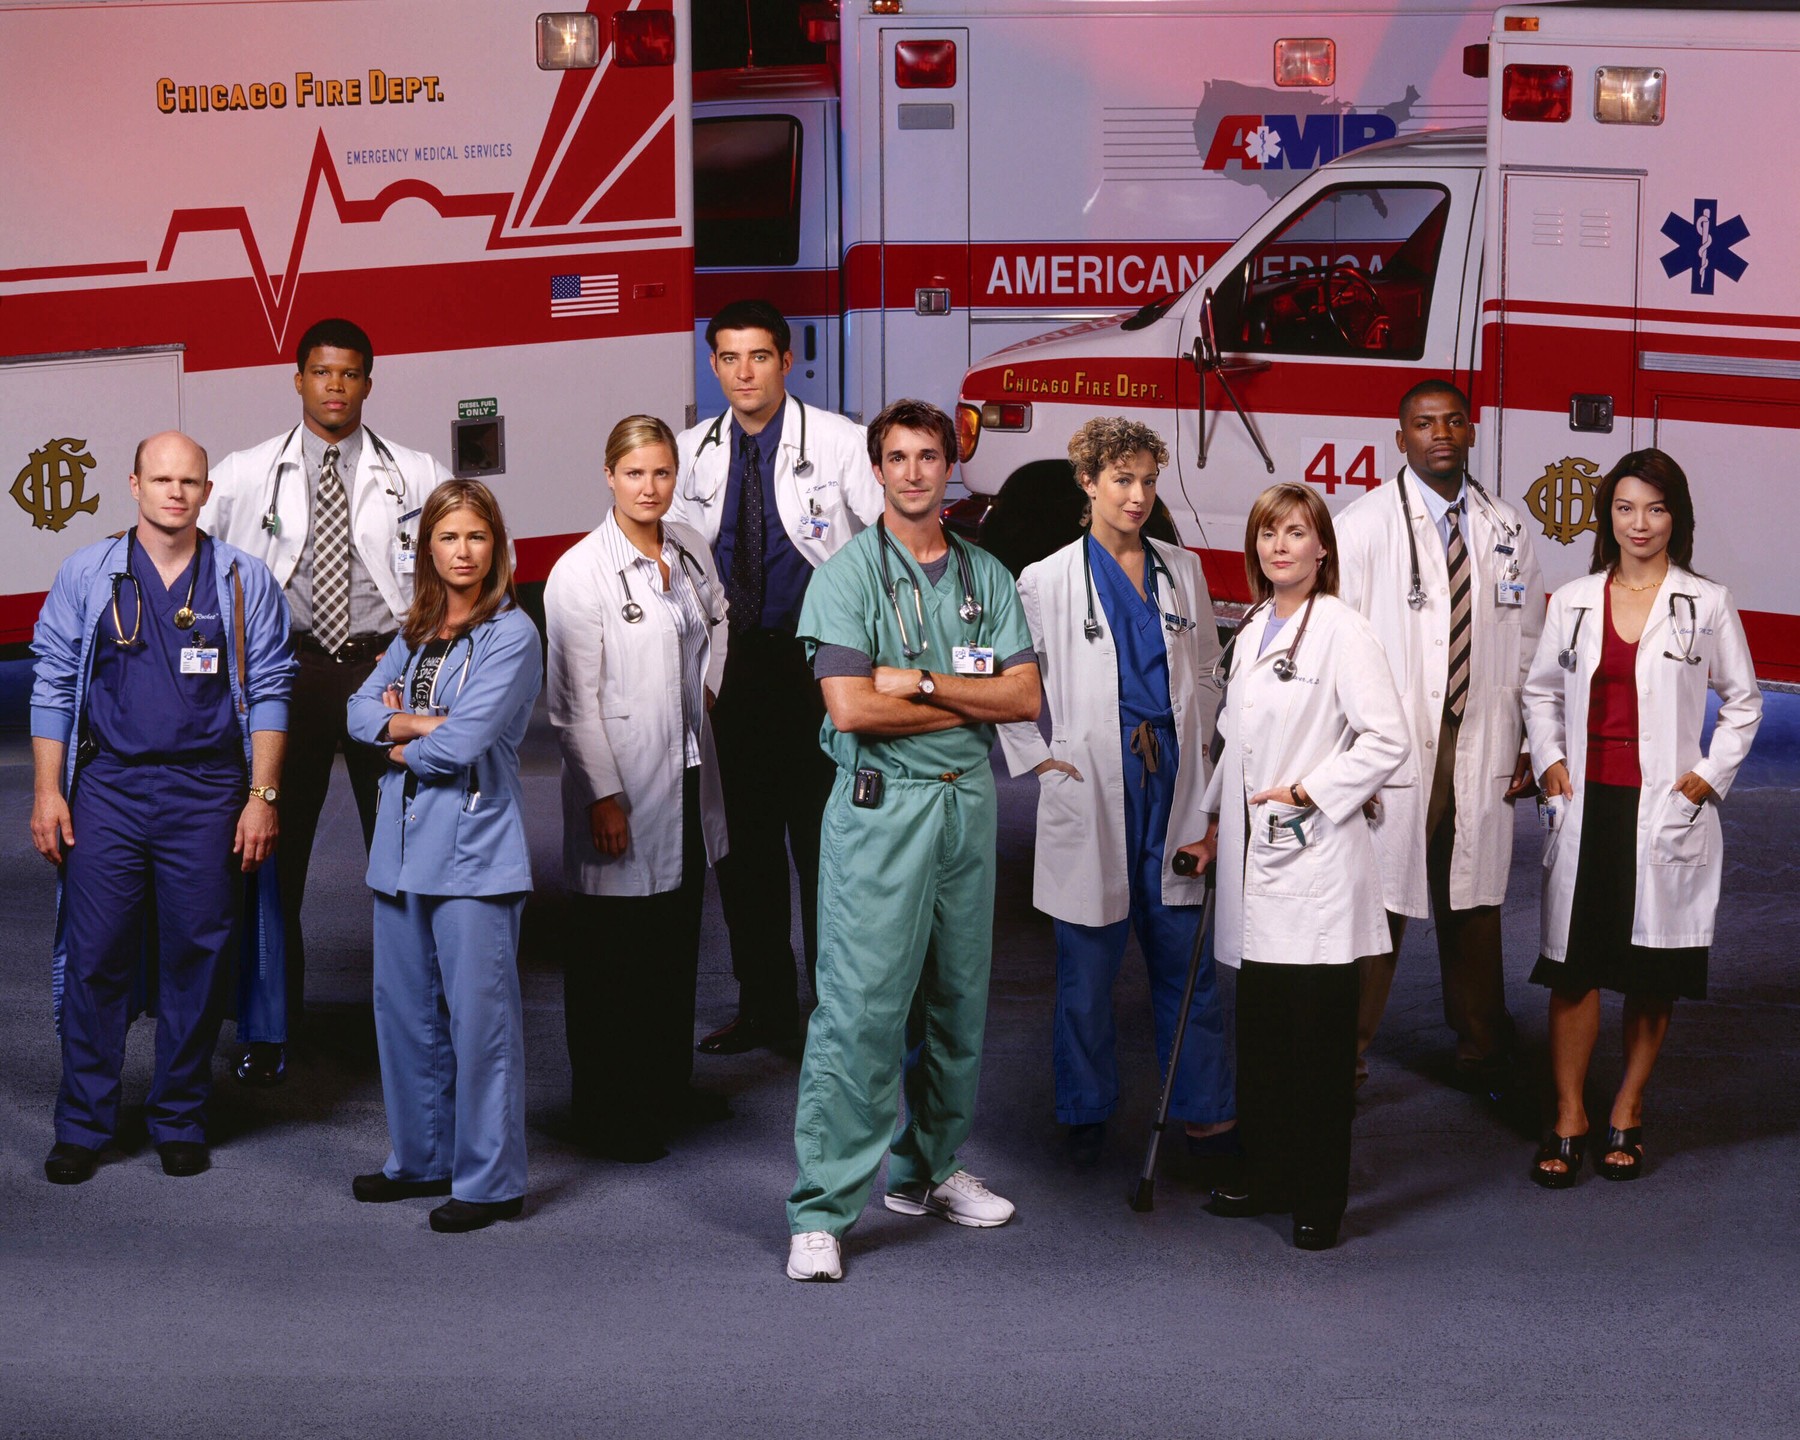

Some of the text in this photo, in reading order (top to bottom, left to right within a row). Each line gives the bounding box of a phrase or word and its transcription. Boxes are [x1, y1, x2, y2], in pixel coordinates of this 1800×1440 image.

[156, 69, 445, 114] CHICAGO FIRE DEPT.
[347, 143, 513, 165] EMERGENCY MEDICAL SERVICES
[986, 255, 1204, 295] AMERICAN
[1003, 368, 1164, 399] CHICAGO FIRE DEPT.
[459, 401, 480, 409] DIESEL
[465, 407, 489, 417] ONLY
[1304, 443, 1382, 495] 44
